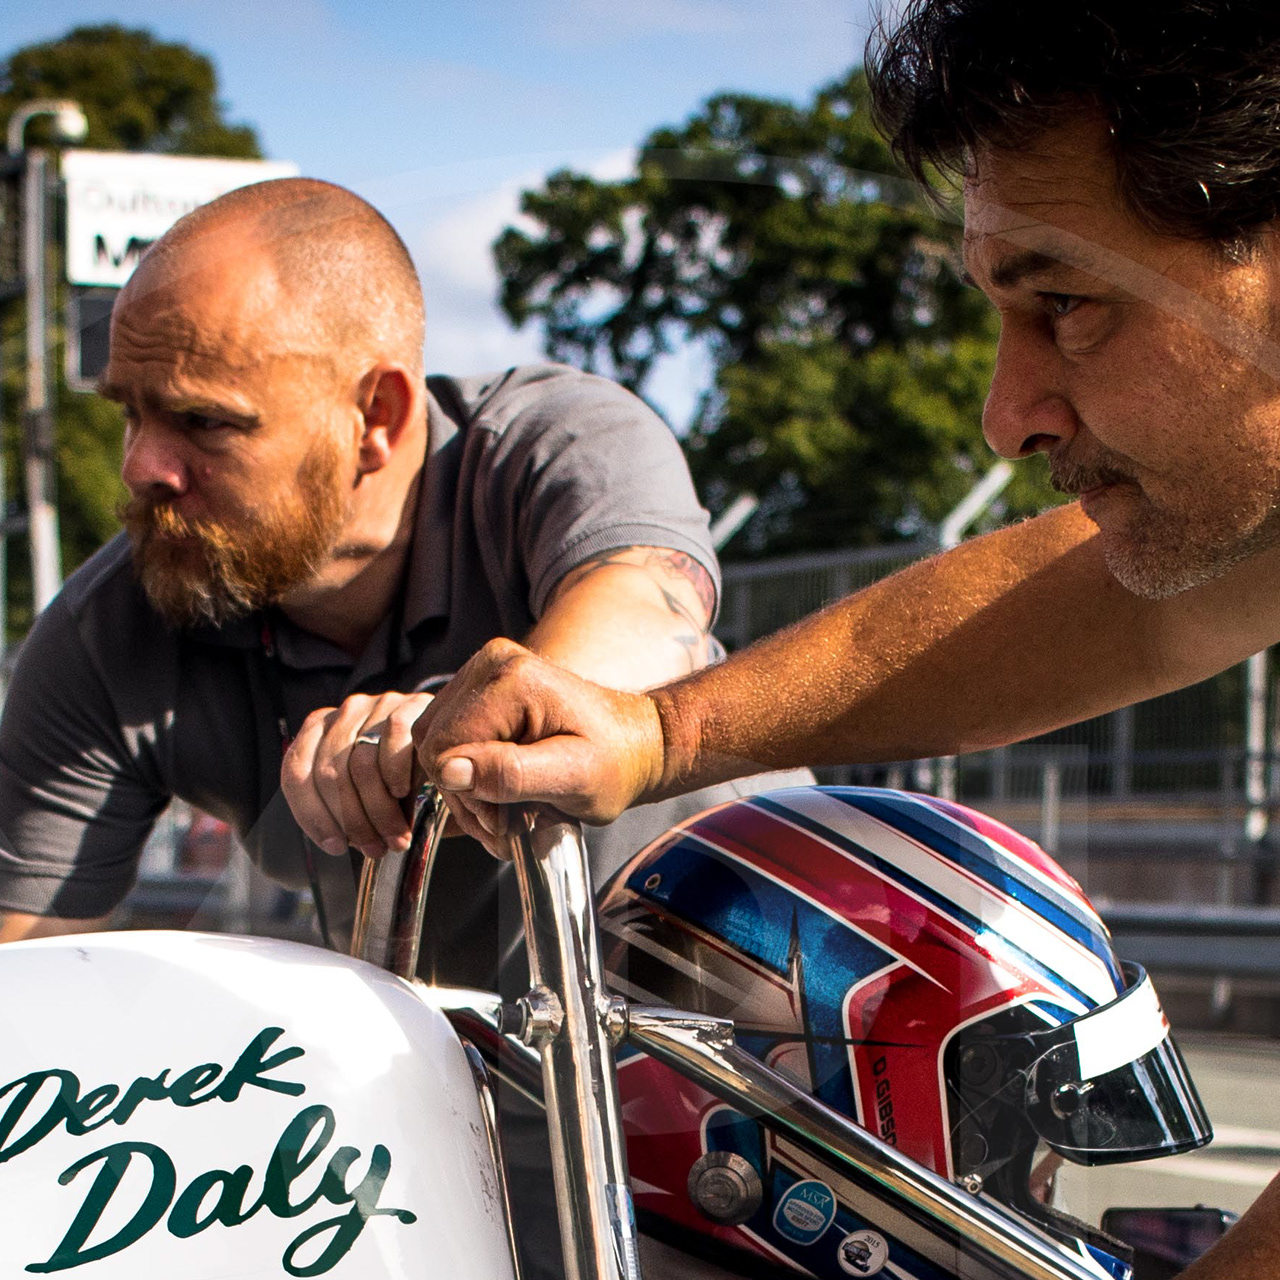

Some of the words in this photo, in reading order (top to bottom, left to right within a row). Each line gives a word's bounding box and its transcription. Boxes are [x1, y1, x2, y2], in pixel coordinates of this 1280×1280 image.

[24, 1104, 417, 1278] Daly
[800, 1187, 828, 1209] MSA
[864, 1234, 880, 1248] 2015
